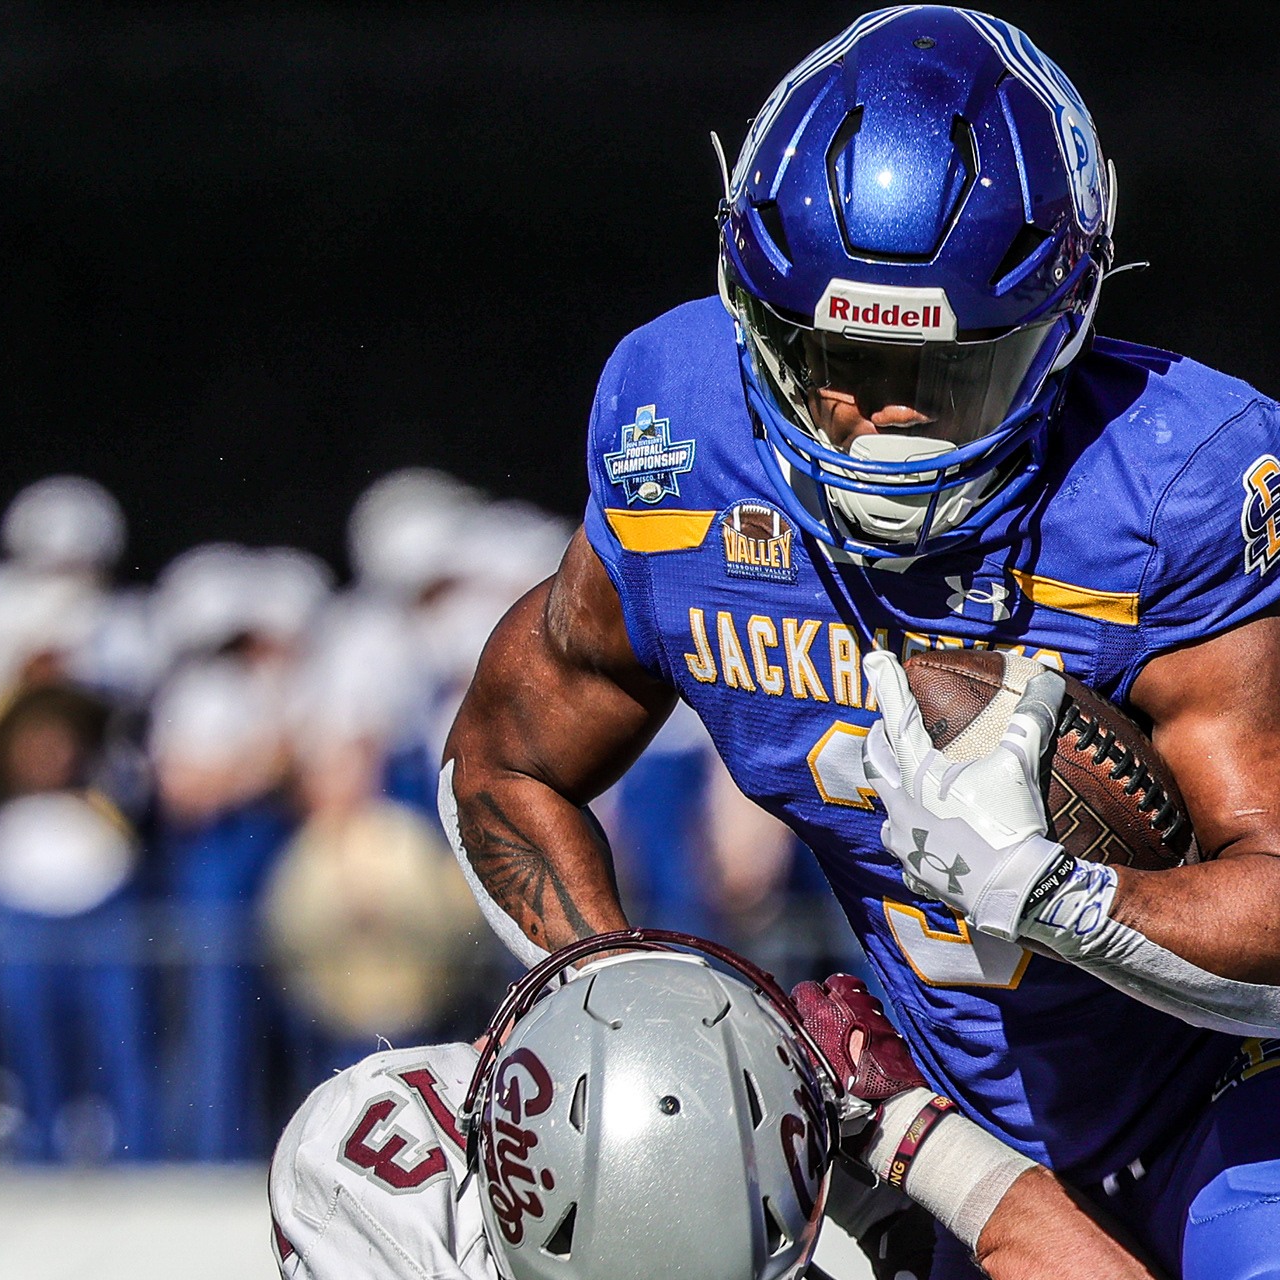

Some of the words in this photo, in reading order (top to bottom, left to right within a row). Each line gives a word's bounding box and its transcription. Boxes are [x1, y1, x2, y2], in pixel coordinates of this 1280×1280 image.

[829, 296, 941, 328] Riddell
[612, 450, 687, 475] CHAMPIONSHIP
[626, 443, 664, 459] FOOTBALL
[721, 521, 792, 569] VALLEY
[764, 566, 791, 575] VALLEY
